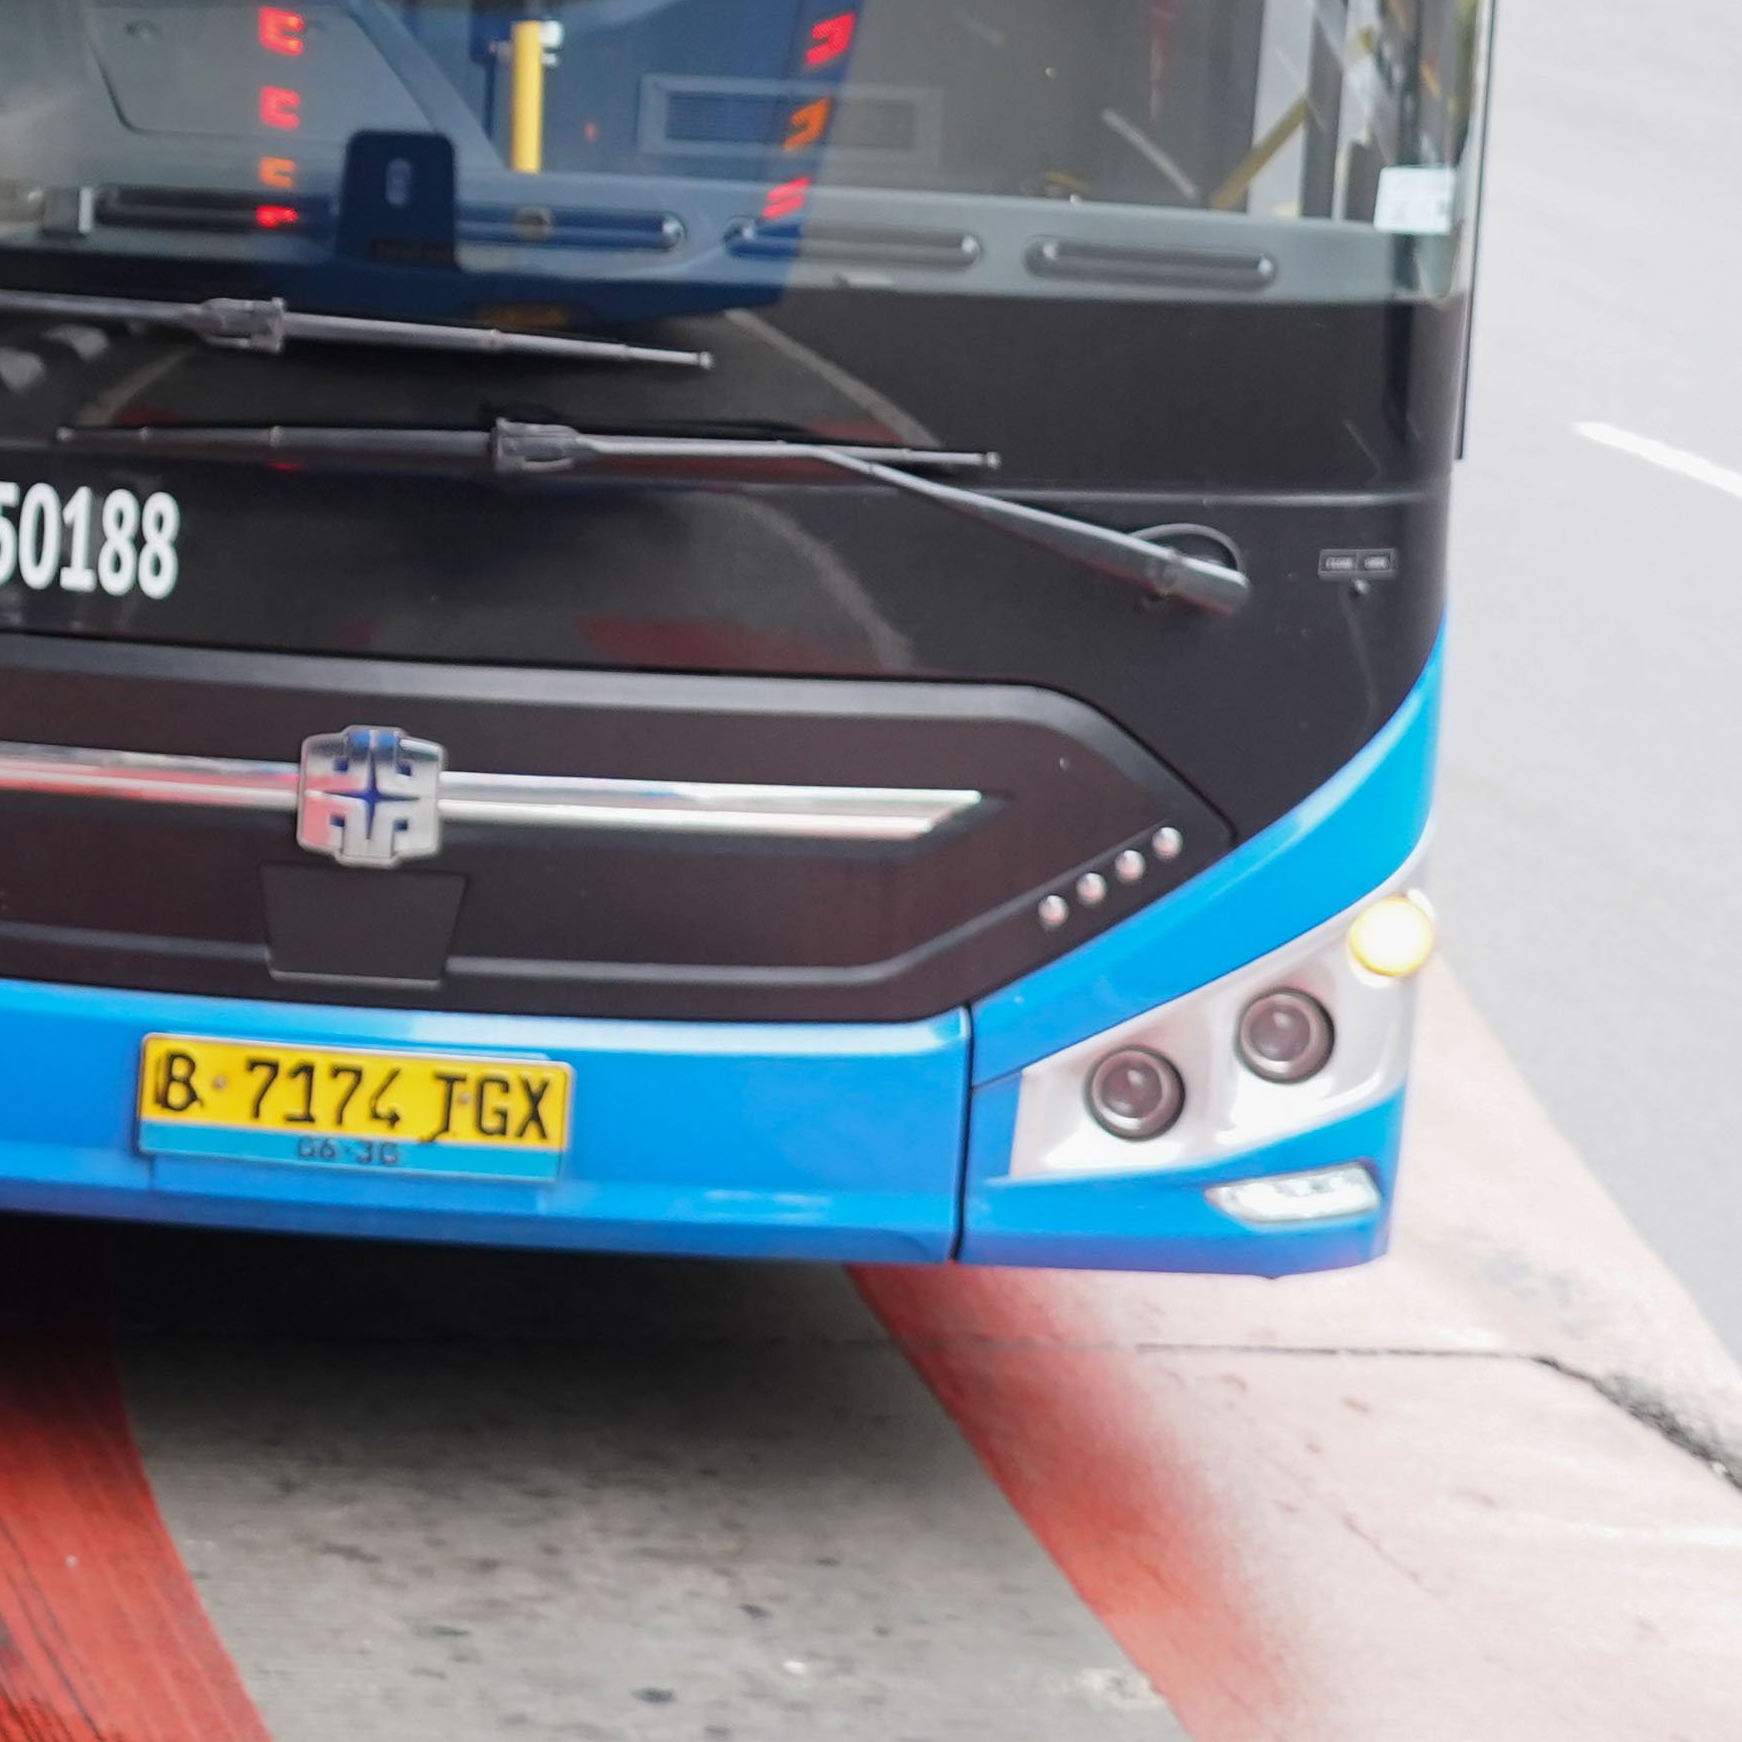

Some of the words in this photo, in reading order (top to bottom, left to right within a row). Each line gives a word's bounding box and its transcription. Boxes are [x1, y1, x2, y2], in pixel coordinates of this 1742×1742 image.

[156, 1052, 203, 1113] B
[245, 1059, 403, 1130] 7174
[428, 1073, 552, 1143] TGX
